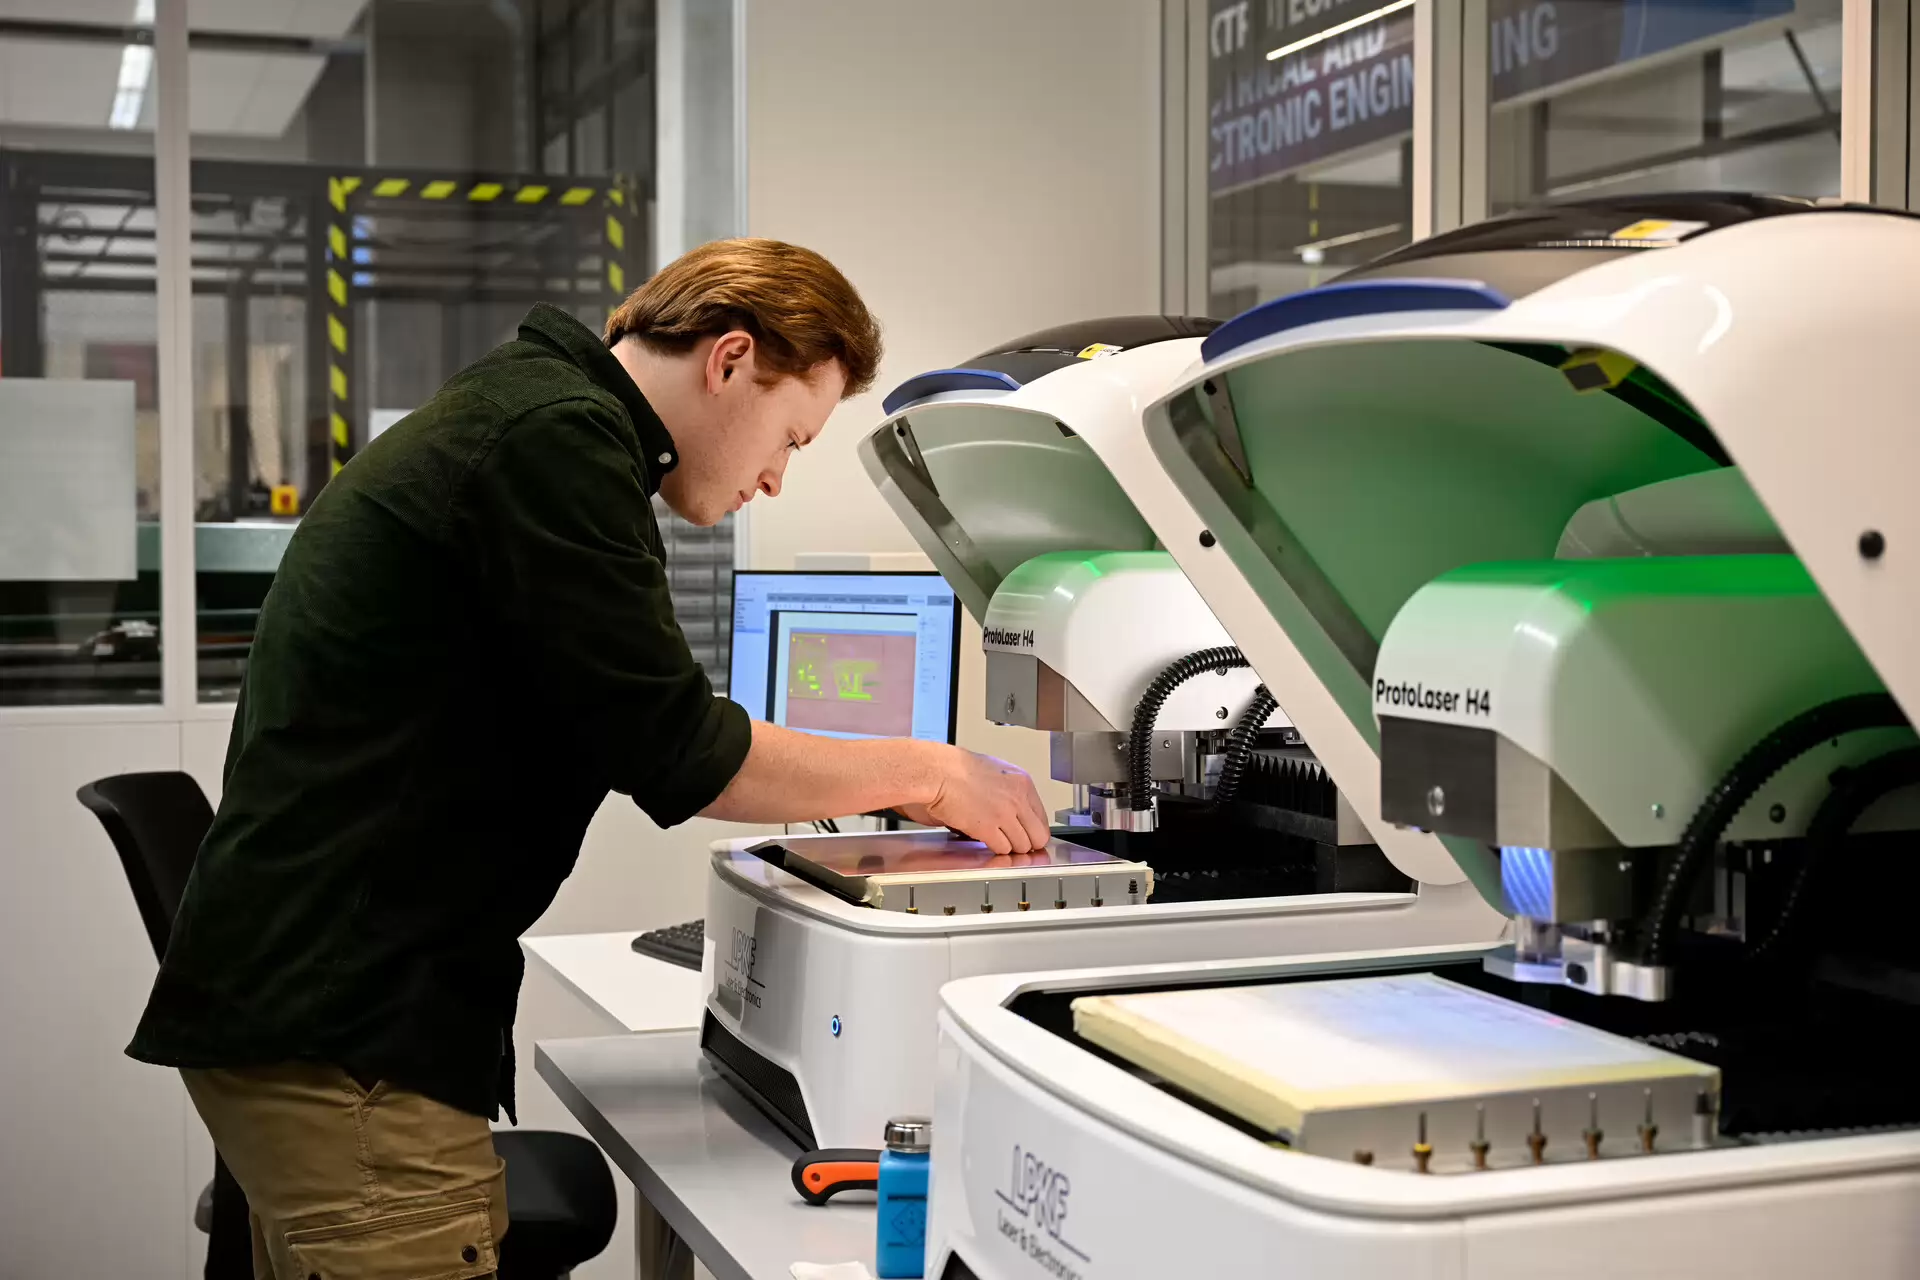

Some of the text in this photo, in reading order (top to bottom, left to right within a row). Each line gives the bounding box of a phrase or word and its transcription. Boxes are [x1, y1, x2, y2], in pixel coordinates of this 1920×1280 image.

[1322, 27, 1386, 74] AND
[983, 626, 1034, 647] ProtoLaser H4
[1376, 678, 1491, 717] ProtoLaser H4
